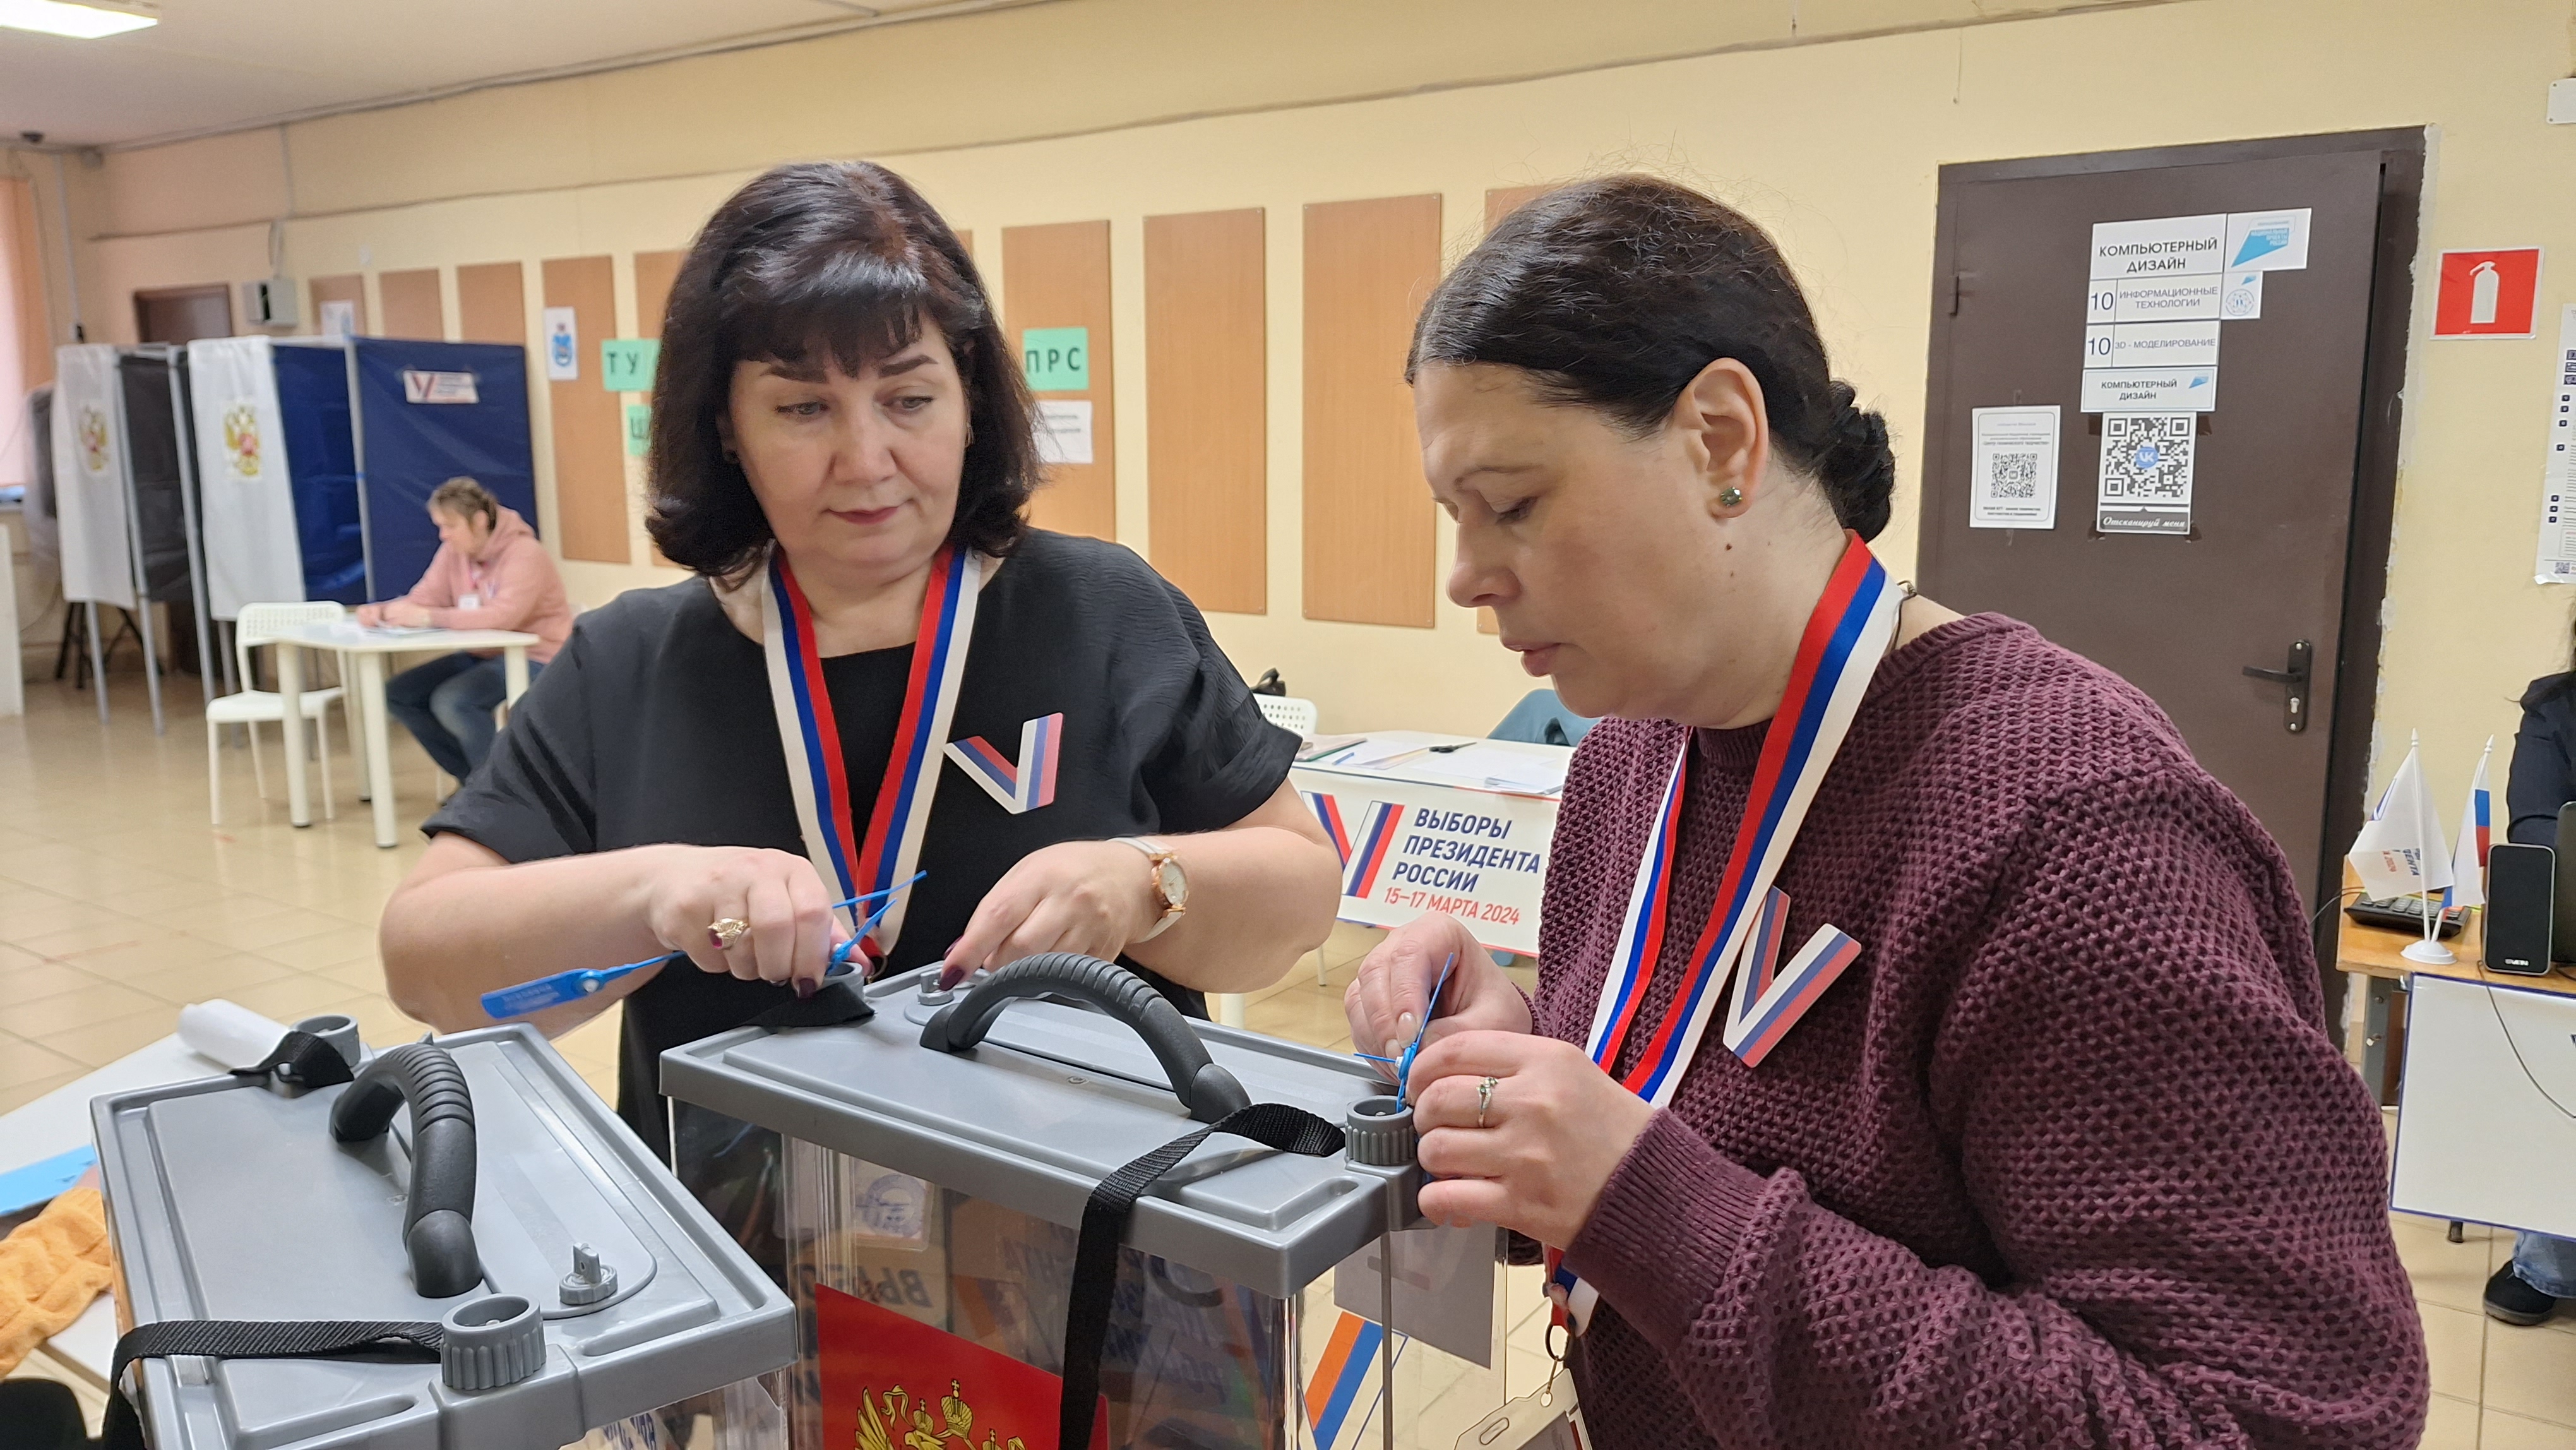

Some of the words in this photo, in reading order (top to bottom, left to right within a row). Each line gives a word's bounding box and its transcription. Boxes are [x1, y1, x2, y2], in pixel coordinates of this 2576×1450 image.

[2099, 237, 2217, 256] КОМПЬЮТЕРНЫЙ
[2126, 256, 2186, 273] ДИЗАЙН
[2090, 292, 2114, 310] 10
[2120, 287, 2218, 299] ИНФОРМАЦИОННЫЕ
[2135, 299, 2200, 309] ТЕХНОЛОГИИ
[2088, 337, 2111, 356] 10
[2133, 339, 2215, 349] МОДЕЛИРОВАНИЕ
[2101, 379, 2177, 388] КОМПЬЮТЕРНЫЙ
[2119, 391, 2156, 400] ДИЗАЙН
[1414, 808, 1513, 839] ВЫБОРЫ
[1402, 834, 1541, 873] ПРЕЗИДЕНТА
[1392, 861, 1480, 893] РОССИИ
[1426, 894, 1480, 918] МАРТА
[1480, 903, 1521, 925] 2024
